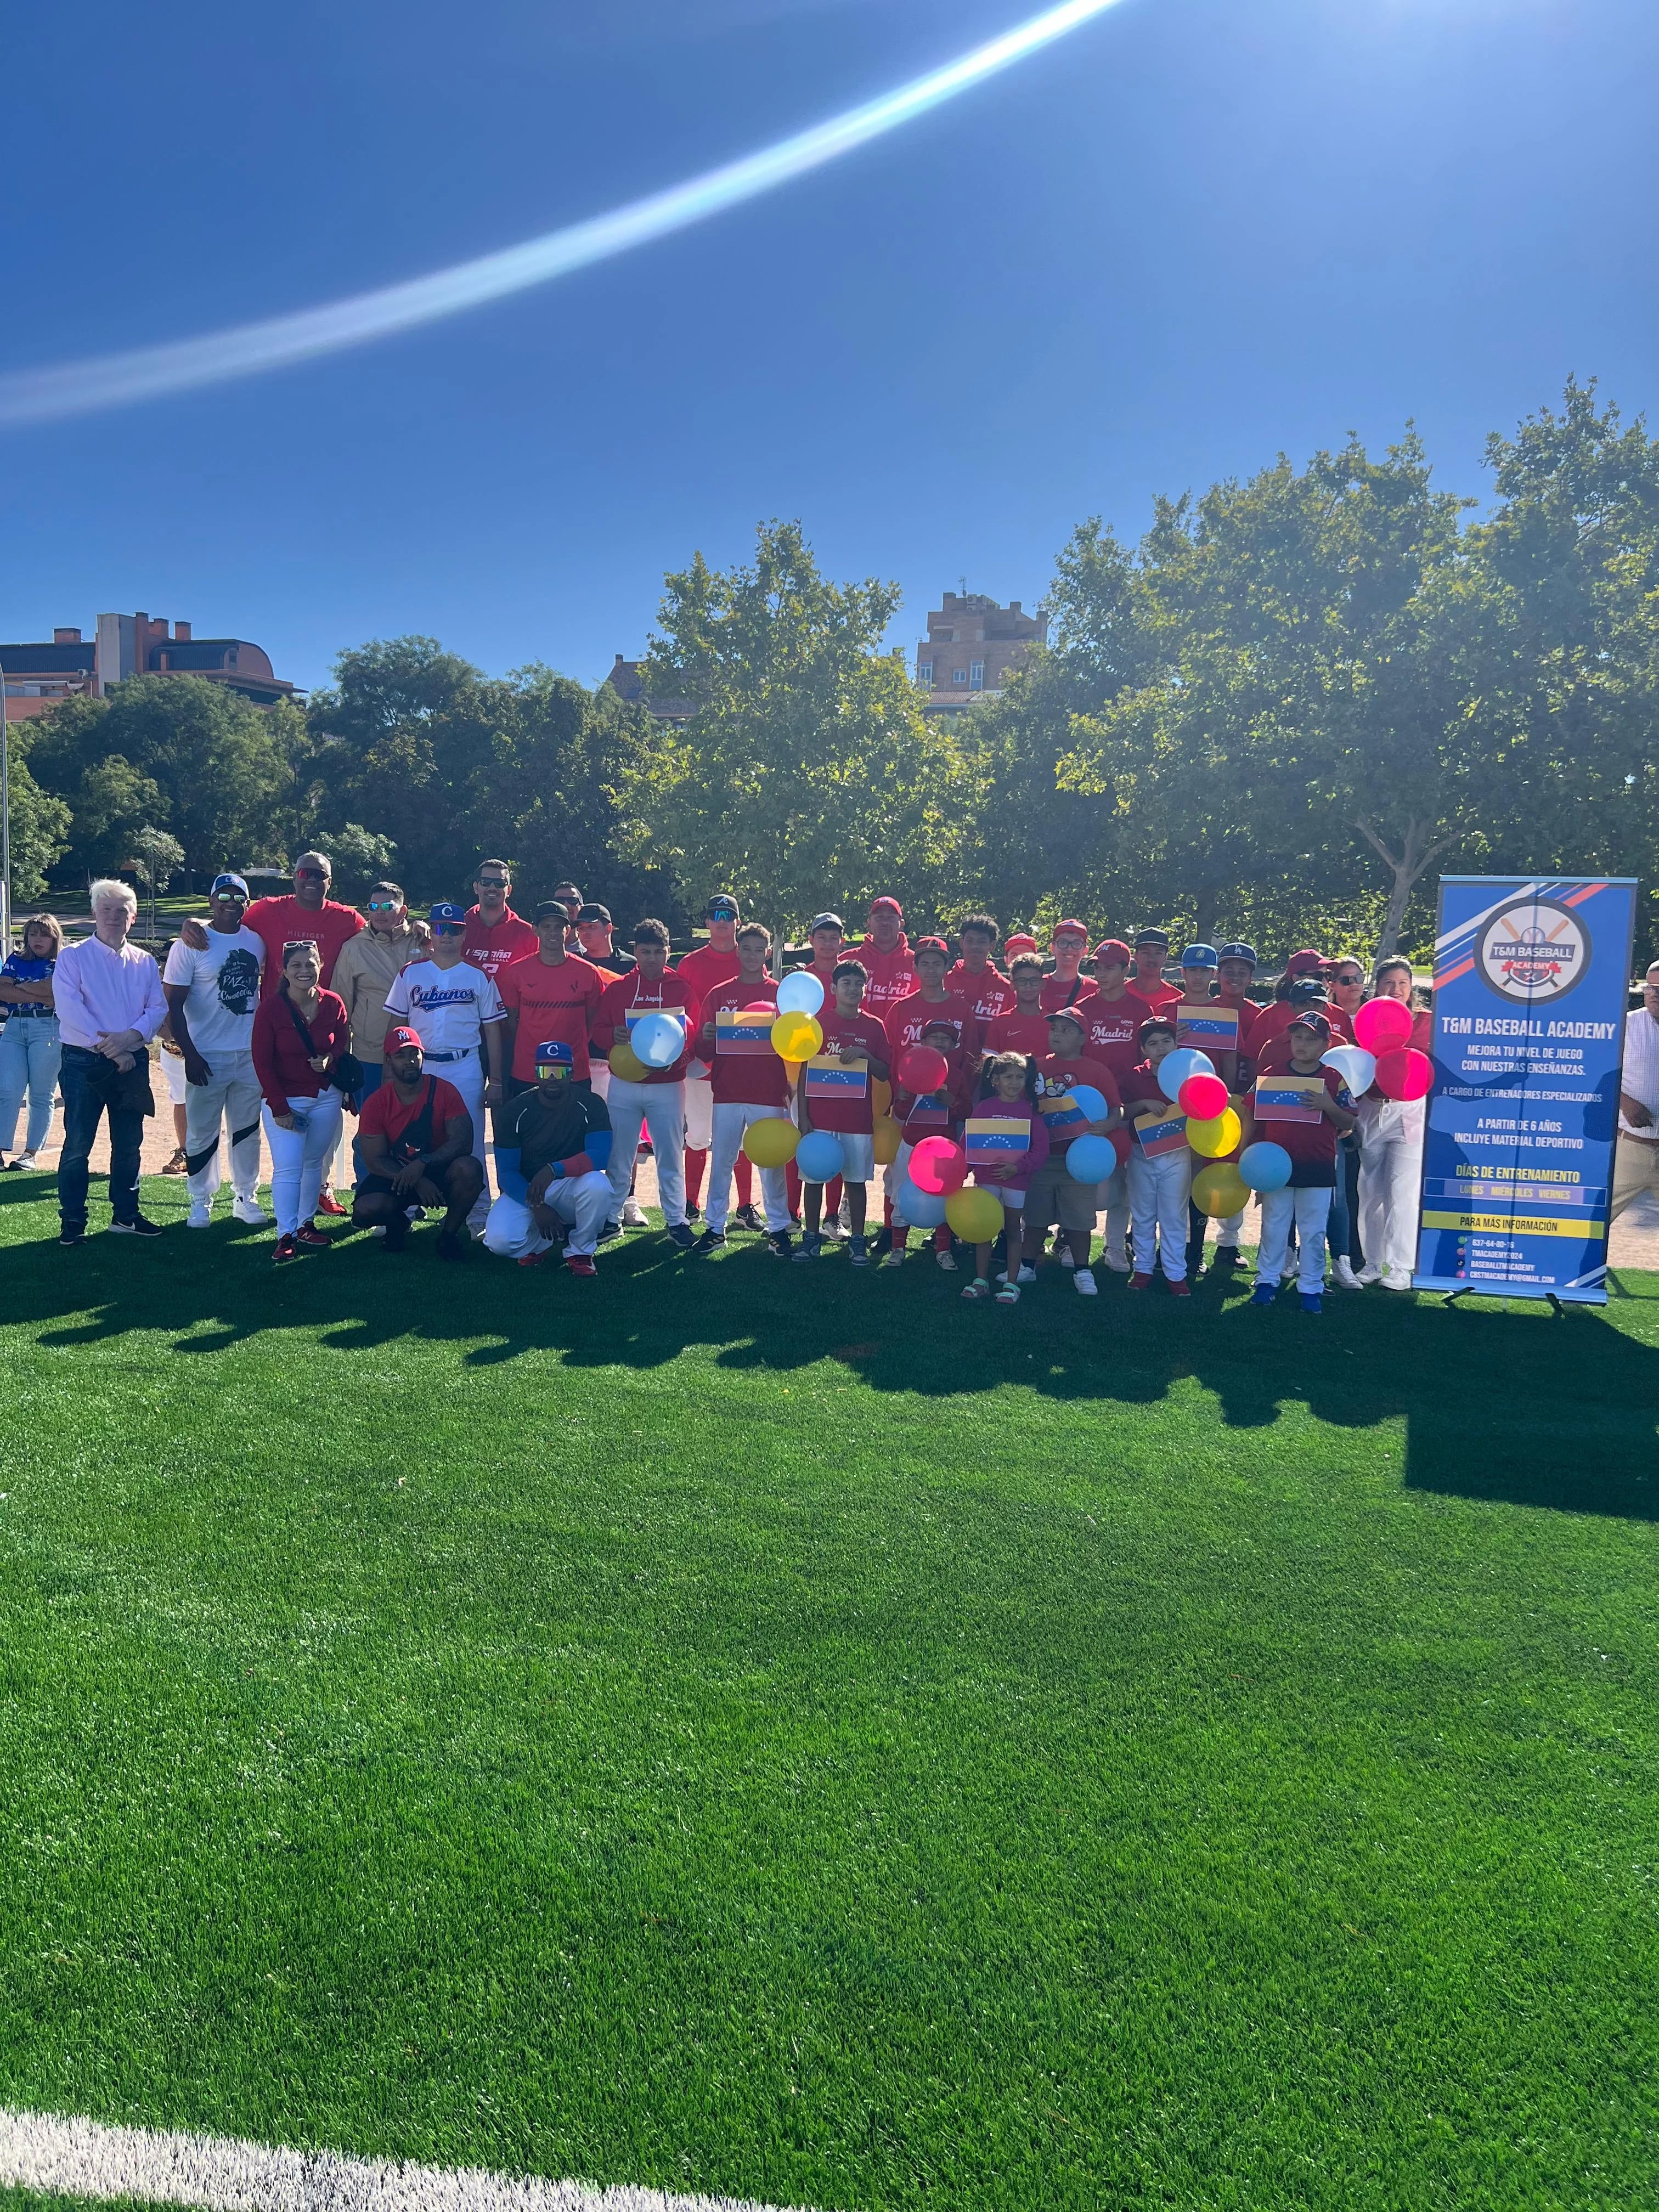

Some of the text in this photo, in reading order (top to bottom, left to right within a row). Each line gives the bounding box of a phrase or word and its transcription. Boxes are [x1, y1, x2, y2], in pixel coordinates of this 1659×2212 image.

[441, 906, 453, 917] C
[287, 930, 325, 940] HILFIGER
[1234, 944, 1243, 955] LA
[1493, 946, 1573, 958] T&M BASEBALL
[1511, 962, 1551, 970] ACADEMY
[222, 975, 247, 988] PAZ
[410, 985, 476, 1008] Cubanos
[398, 1030, 410, 1040] NY
[1090, 1025, 1133, 1041] Madrid
[1441, 1017, 1616, 1040] T&M BASEBALL ACADEMY
[546, 1044, 559, 1056] C
[1466, 1044, 1583, 1060] MEJORA TU NIVEL DE JUEGO
[1461, 1059, 1587, 1076] CON NUESTRAS ENSEÑANZAS.
[1442, 1087, 1602, 1103] A CARGO DE ENTRENADORES ESPECIALIZADOS
[1476, 1118, 1563, 1132] A PARTIR DE 6 AÑOS
[1454, 1132, 1584, 1149] INCLUYE MATERIAL DEPORTIVO
[1455, 1163, 1581, 1183] DÍAS DE ENTRENAMIENTO
[1459, 1184, 1571, 1200] LUNES MIÉRCOLES VIERNES
[1459, 1216, 1558, 1232] PARA MÁS INFORMACIÓN
[1471, 1249, 1523, 1260] TMACADEMY2024
